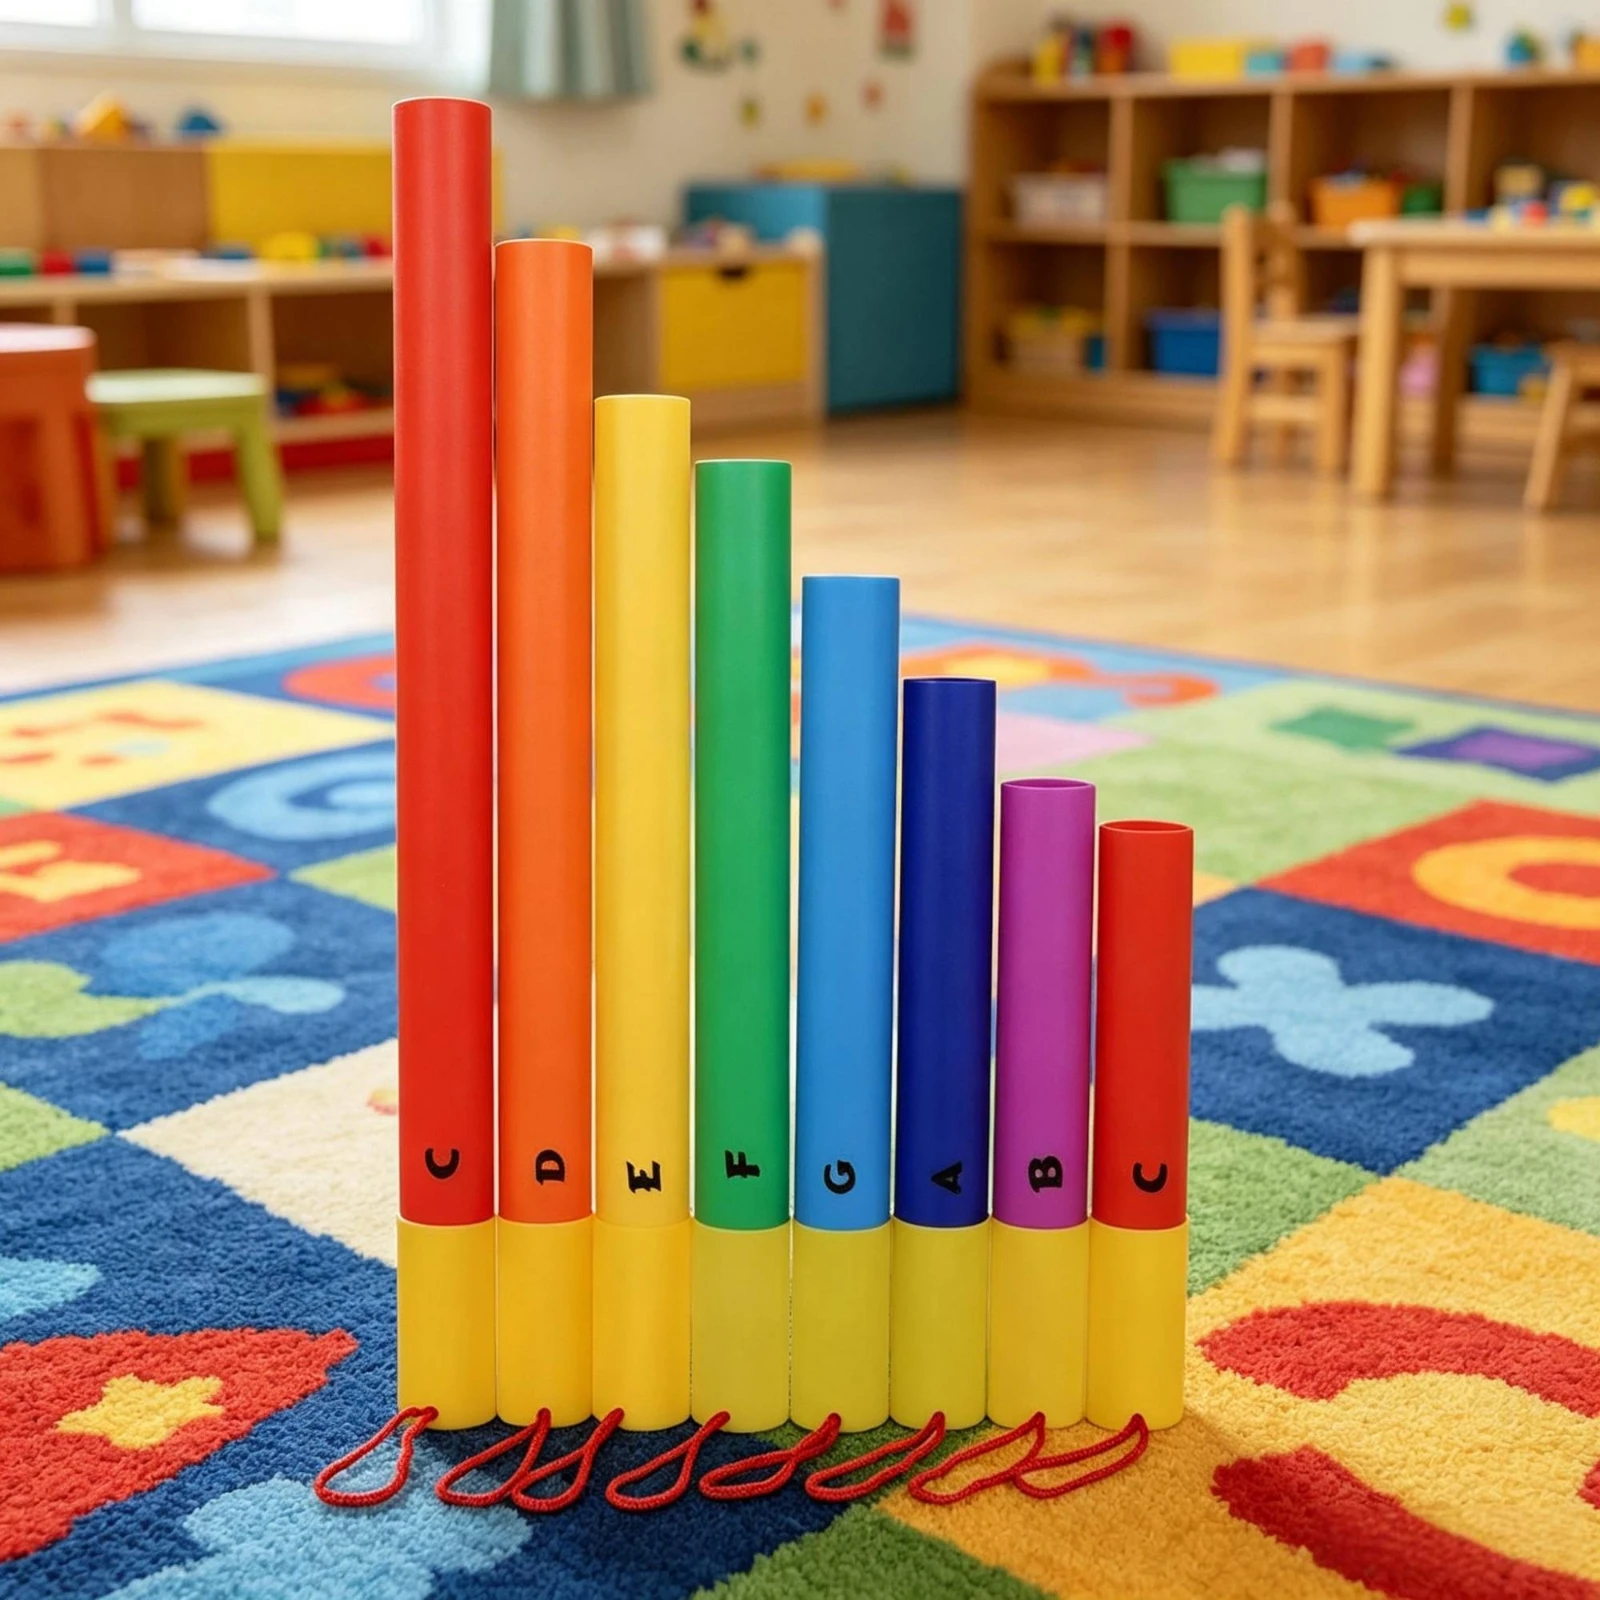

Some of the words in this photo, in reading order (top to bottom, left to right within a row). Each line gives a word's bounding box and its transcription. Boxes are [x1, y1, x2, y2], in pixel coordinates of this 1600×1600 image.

[425, 1149, 460, 1179] C
[535, 1149, 565, 1184] D
[627, 1161, 661, 1193] E
[725, 1150, 760, 1179] F
[824, 1160, 856, 1195] G
[930, 1161, 963, 1195] A
[1028, 1155, 1063, 1193] B
[1133, 1164, 1167, 1193] C
